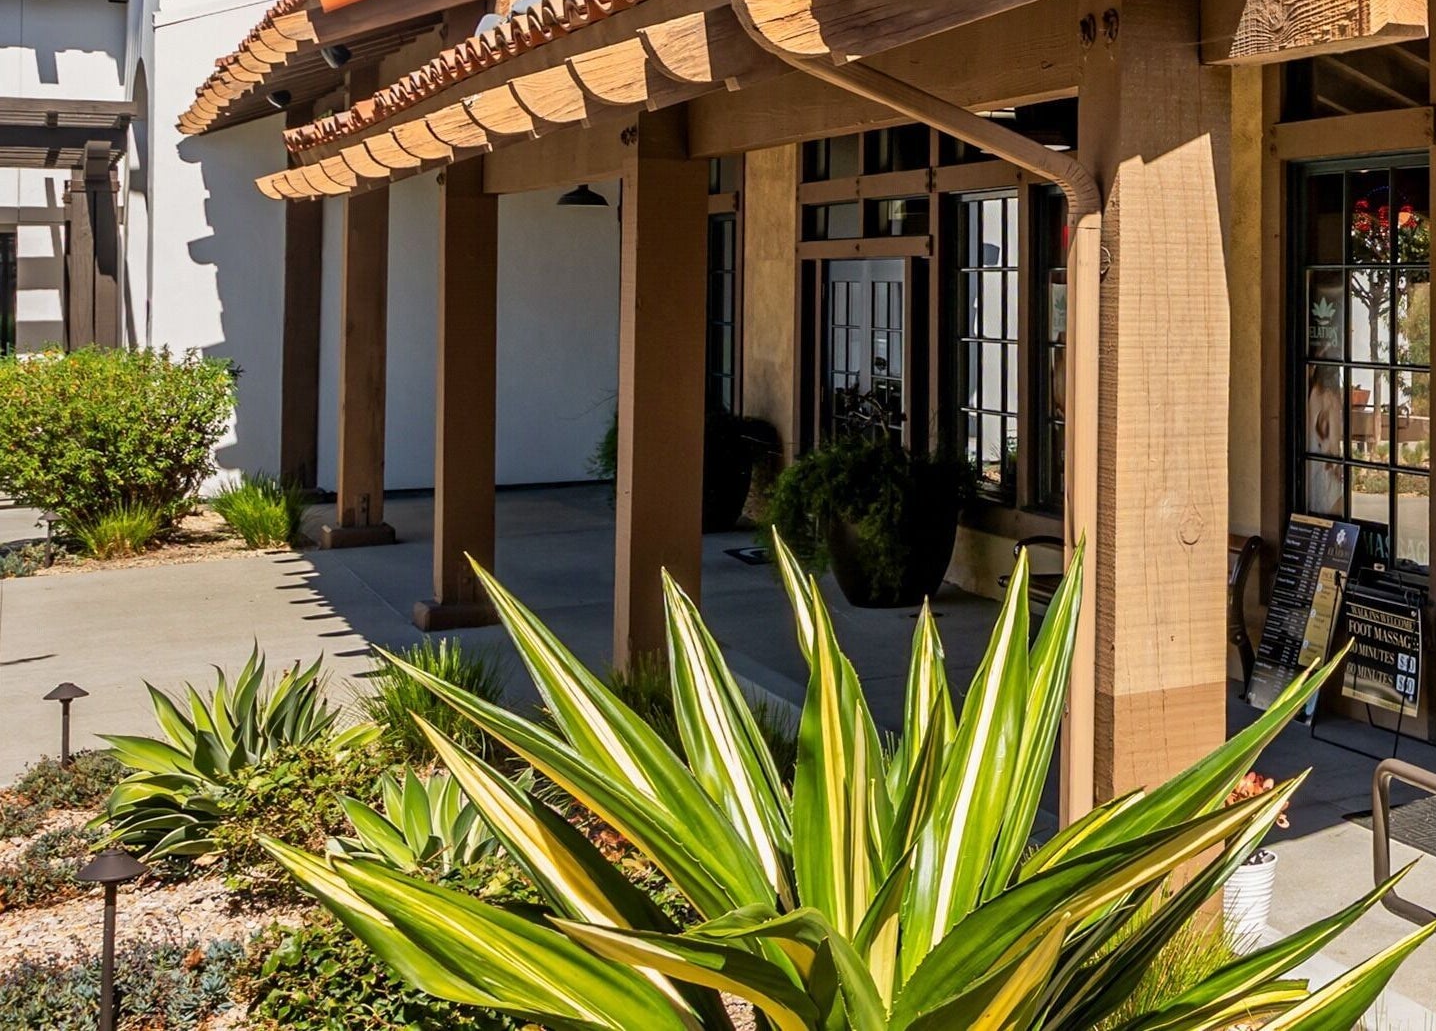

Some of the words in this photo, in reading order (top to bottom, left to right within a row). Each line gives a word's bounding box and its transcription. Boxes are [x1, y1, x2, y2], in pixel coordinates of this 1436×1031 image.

[1348, 619, 1372, 638] FOOT
[1359, 642, 1395, 666] MINUTES
[1357, 664, 1394, 687] MINUTES
